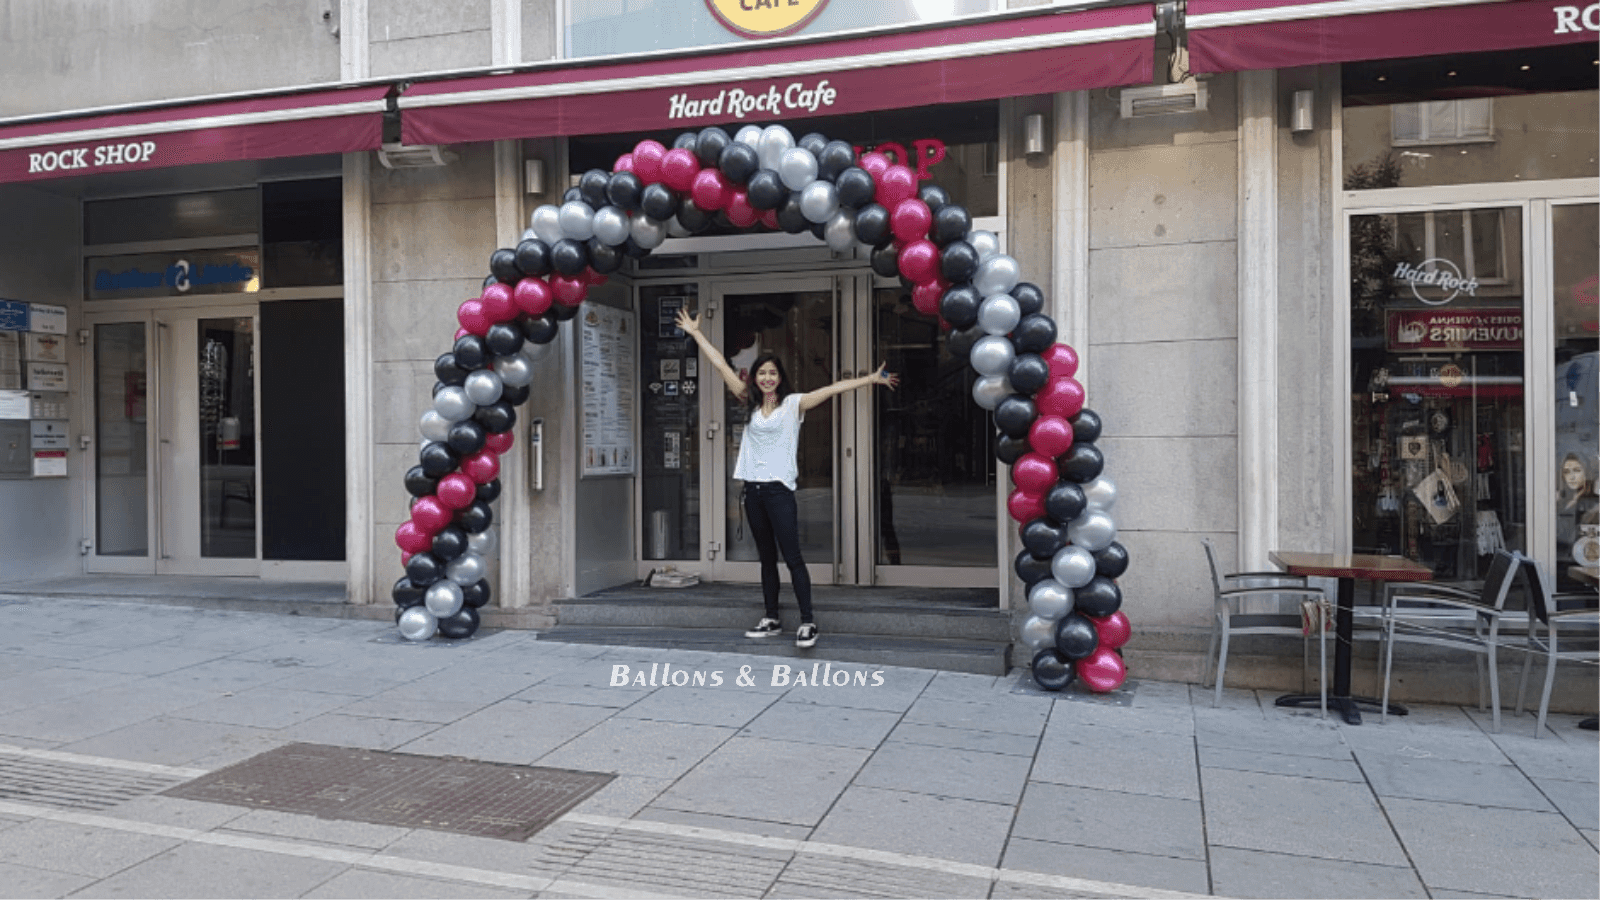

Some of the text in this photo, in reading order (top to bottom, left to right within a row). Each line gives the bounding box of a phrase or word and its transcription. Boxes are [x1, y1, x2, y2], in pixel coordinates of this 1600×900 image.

[669, 80, 837, 119] Hard Rock Cafe
[28, 141, 156, 173] ROCK SHOP
[853, 138, 946, 180] OP
[1393, 261, 1478, 297] Hard Rock
